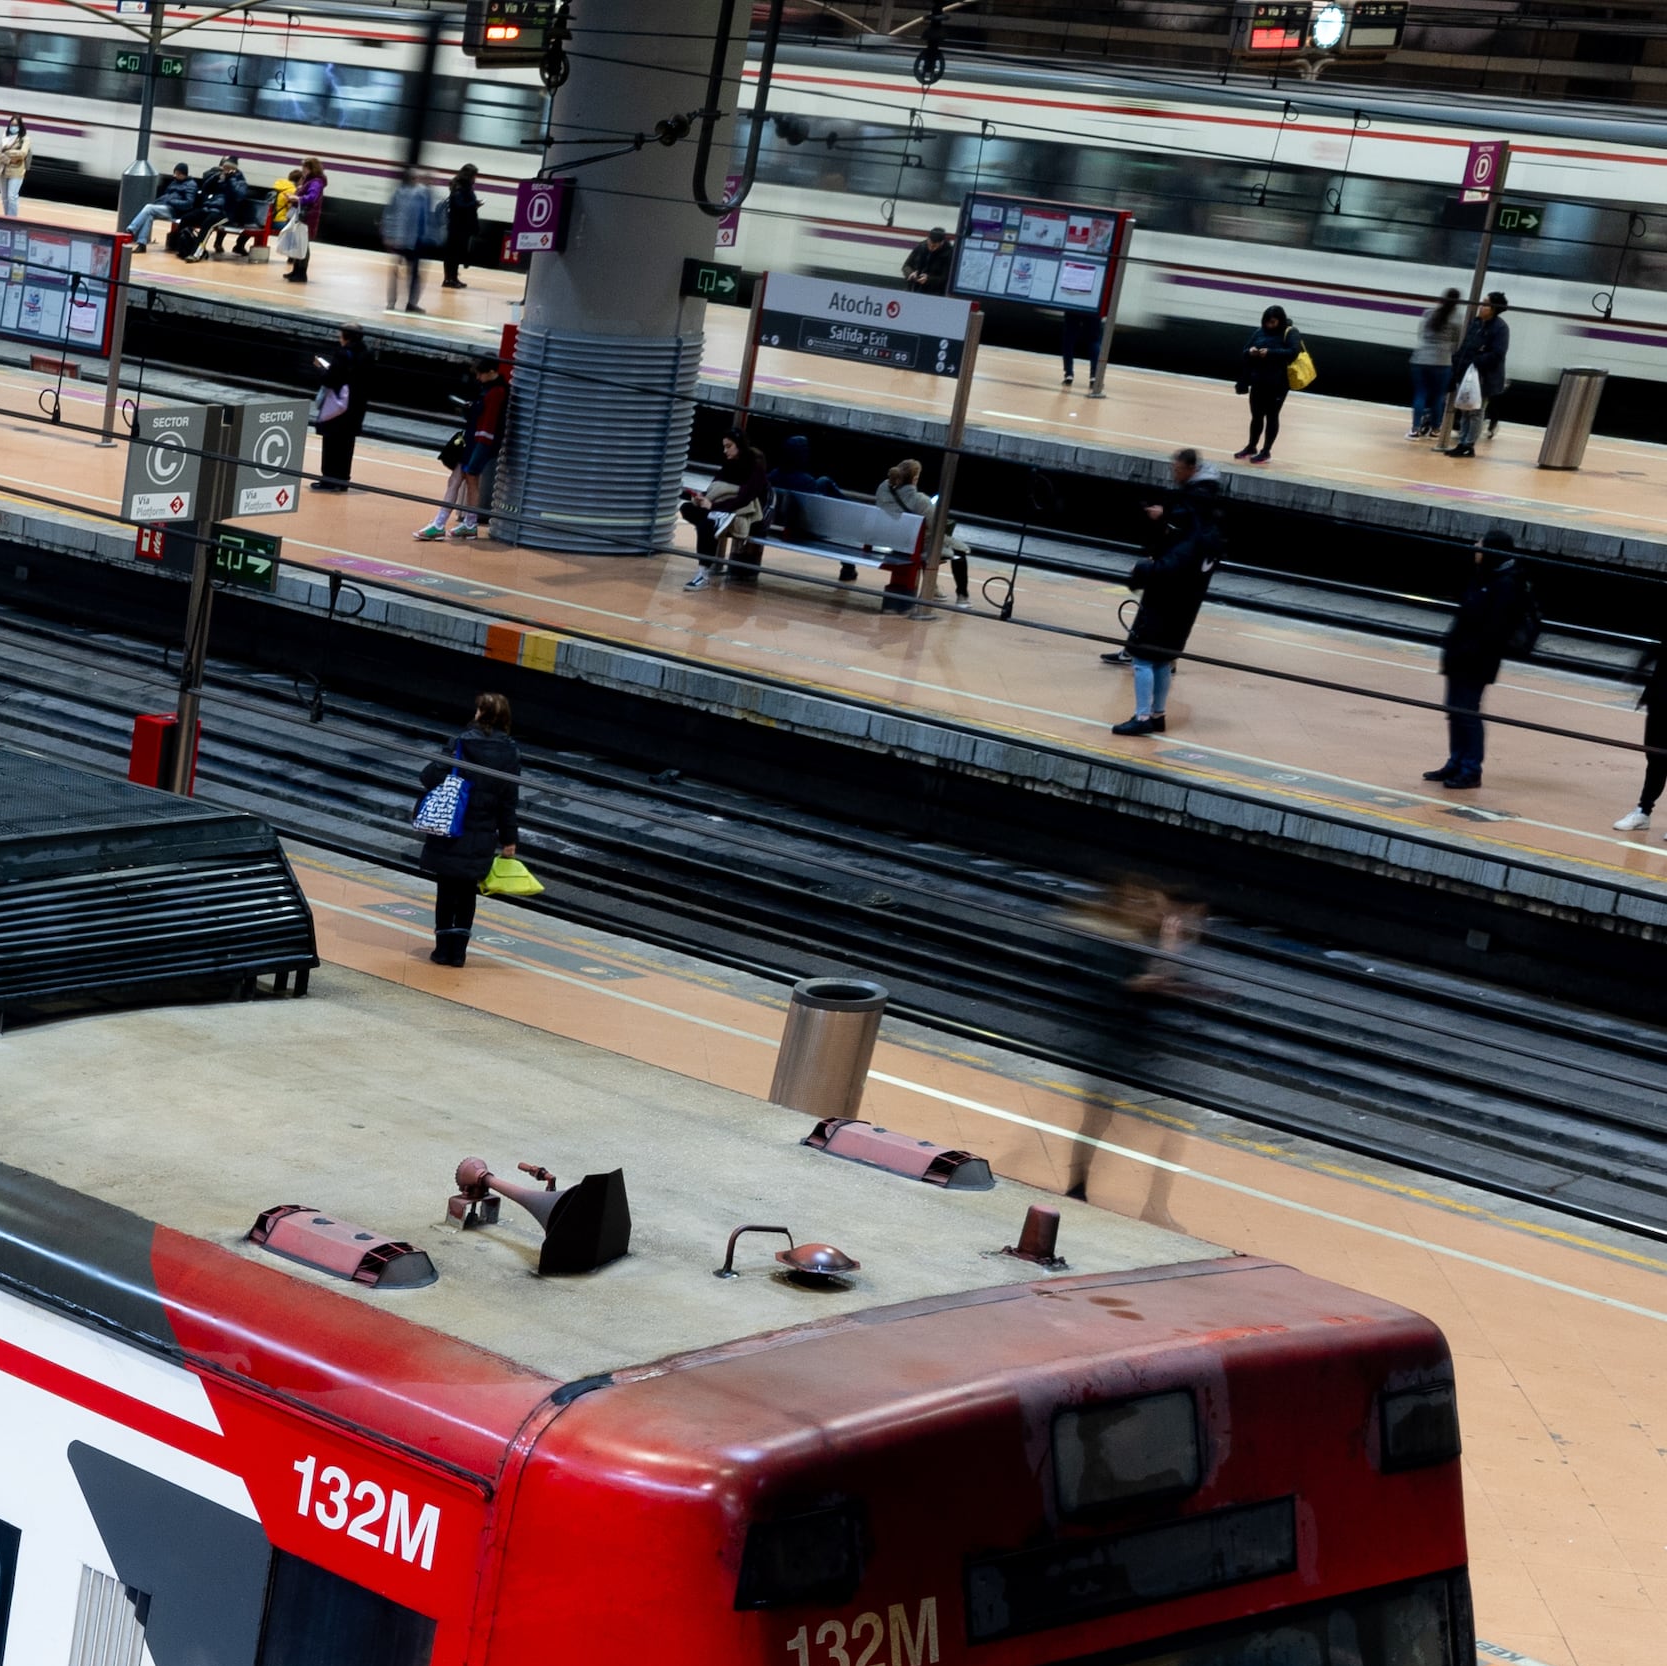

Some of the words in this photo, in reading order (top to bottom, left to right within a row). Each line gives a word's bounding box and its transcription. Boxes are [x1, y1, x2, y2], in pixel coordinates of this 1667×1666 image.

[532, 198, 548, 222] D
[829, 292, 883, 318] Atocha
[152, 416, 190, 428] SECTOR
[259, 411, 295, 424] SECTOR
[154, 439, 178, 477] C
[261, 434, 285, 468] C
[293, 1455, 441, 1571] 132M
